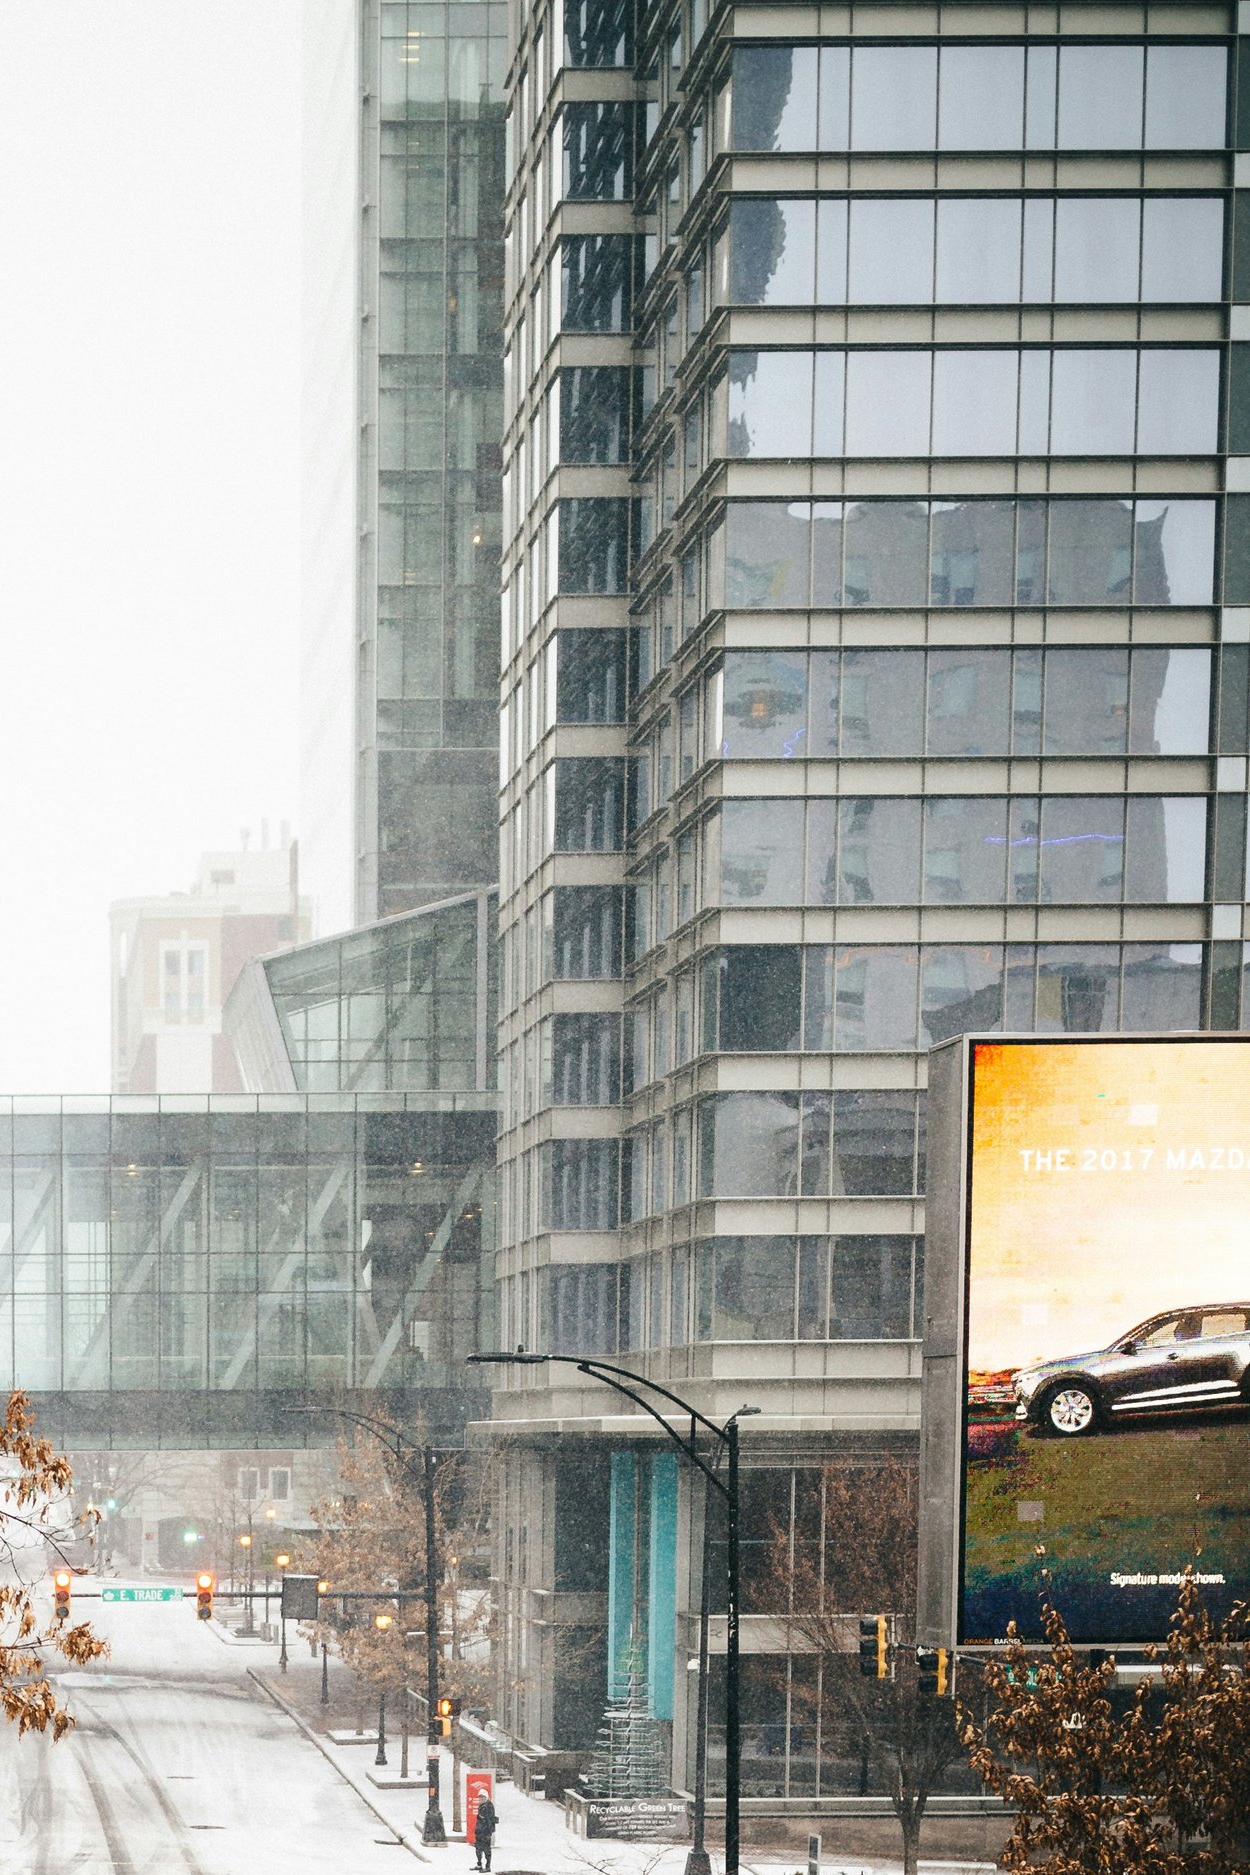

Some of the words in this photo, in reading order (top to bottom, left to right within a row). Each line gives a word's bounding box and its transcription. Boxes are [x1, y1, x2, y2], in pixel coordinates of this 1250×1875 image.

[1019, 1148, 1071, 1172] THE
[1081, 1148, 1155, 1172] 2017
[1165, 1147, 1250, 1171] MAZD
[1110, 1572, 1158, 1588] Signature
[120, 1590, 130, 1600] E.
[134, 1590, 164, 1601] TRADE
[590, 1804, 636, 1814] RECYCLABLE
[638, 1802, 666, 1812] GREEN
[667, 1803, 686, 1812] TREE
